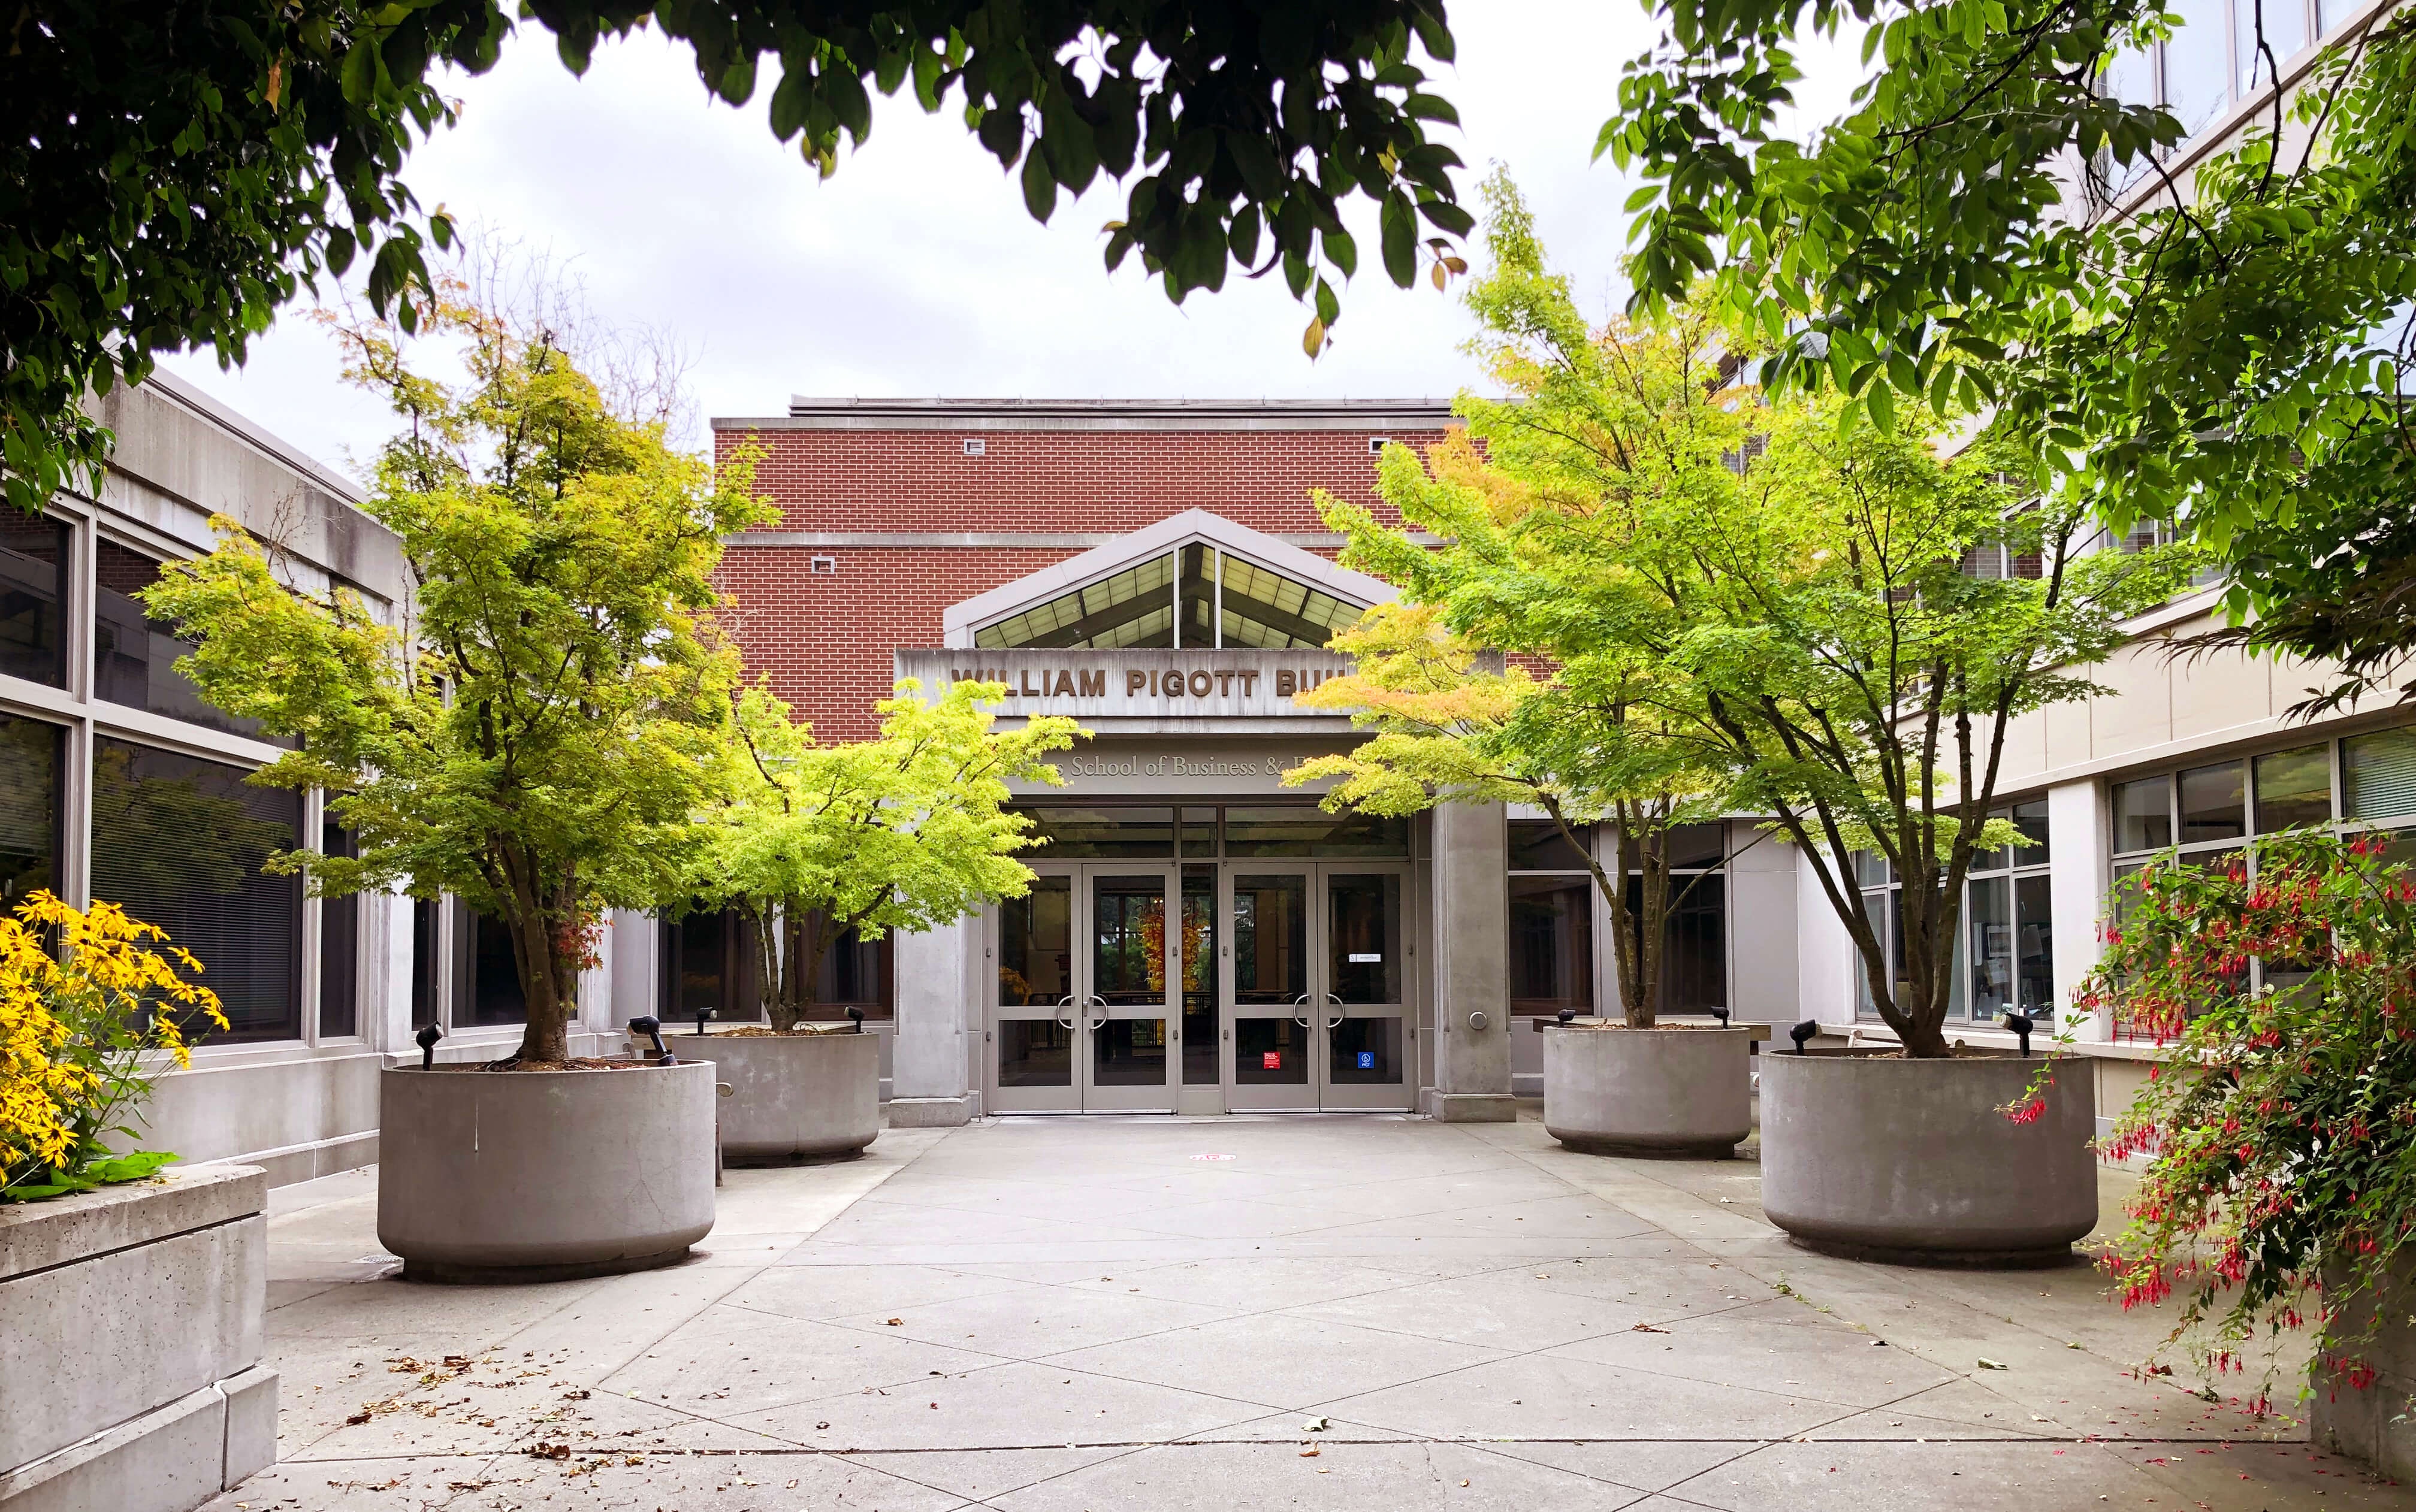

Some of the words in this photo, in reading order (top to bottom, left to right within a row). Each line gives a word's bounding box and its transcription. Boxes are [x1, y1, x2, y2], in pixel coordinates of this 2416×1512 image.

[1126, 669, 1259, 697] PIGOTT
[1071, 754, 1139, 777] School
[1145, 755, 1168, 777] of
[1171, 756, 1257, 777] Business
[1265, 756, 1285, 777] &
